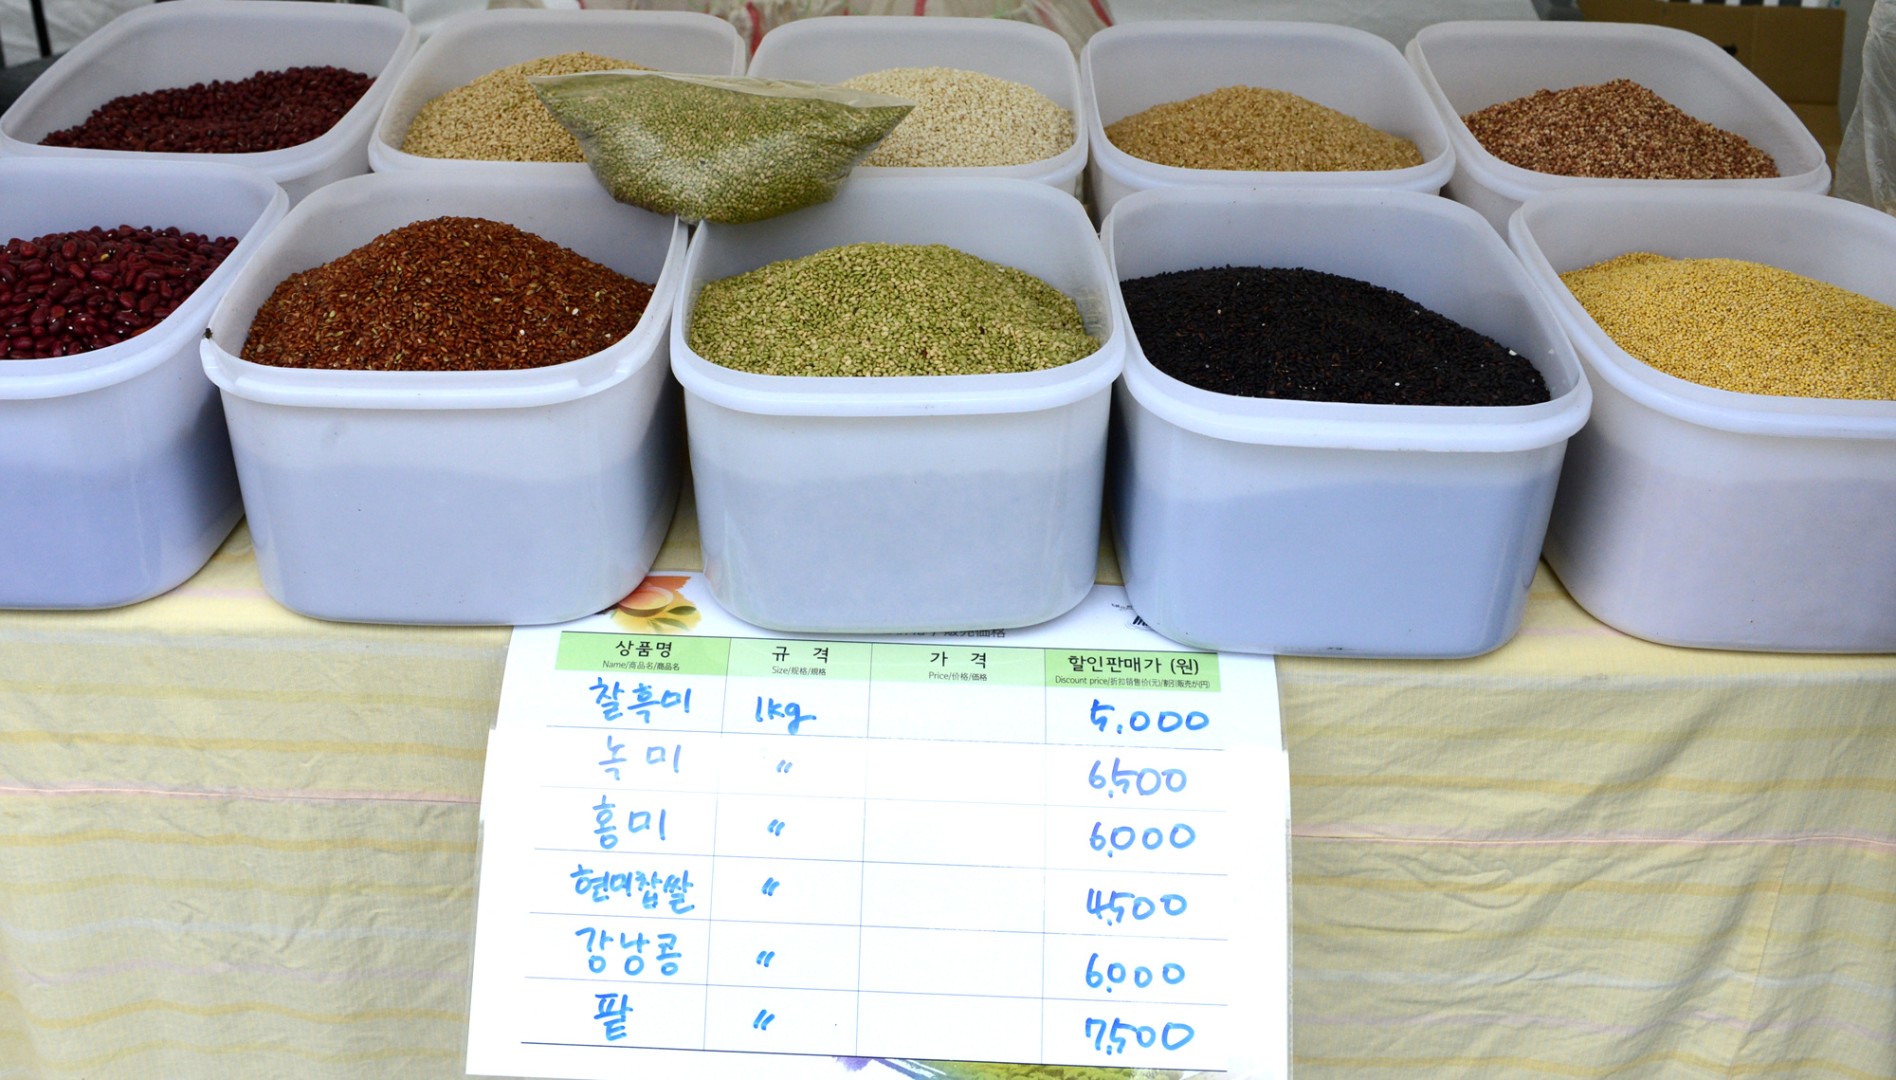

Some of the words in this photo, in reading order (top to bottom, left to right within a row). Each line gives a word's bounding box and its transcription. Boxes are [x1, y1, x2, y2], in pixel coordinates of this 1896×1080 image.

[615, 640, 673, 658] 상품명
[1067, 656, 1163, 674] 할인판매가
[1170, 656, 1200, 676] (원)
[589, 677, 691, 724] 찰흑미
[1055, 675, 1087, 685] Discount
[755, 696, 816, 736] 1kg
[570, 864, 695, 914] 현미찹쌀
[575, 927, 683, 976] 강낭콩
[593, 993, 634, 1041] 팥
